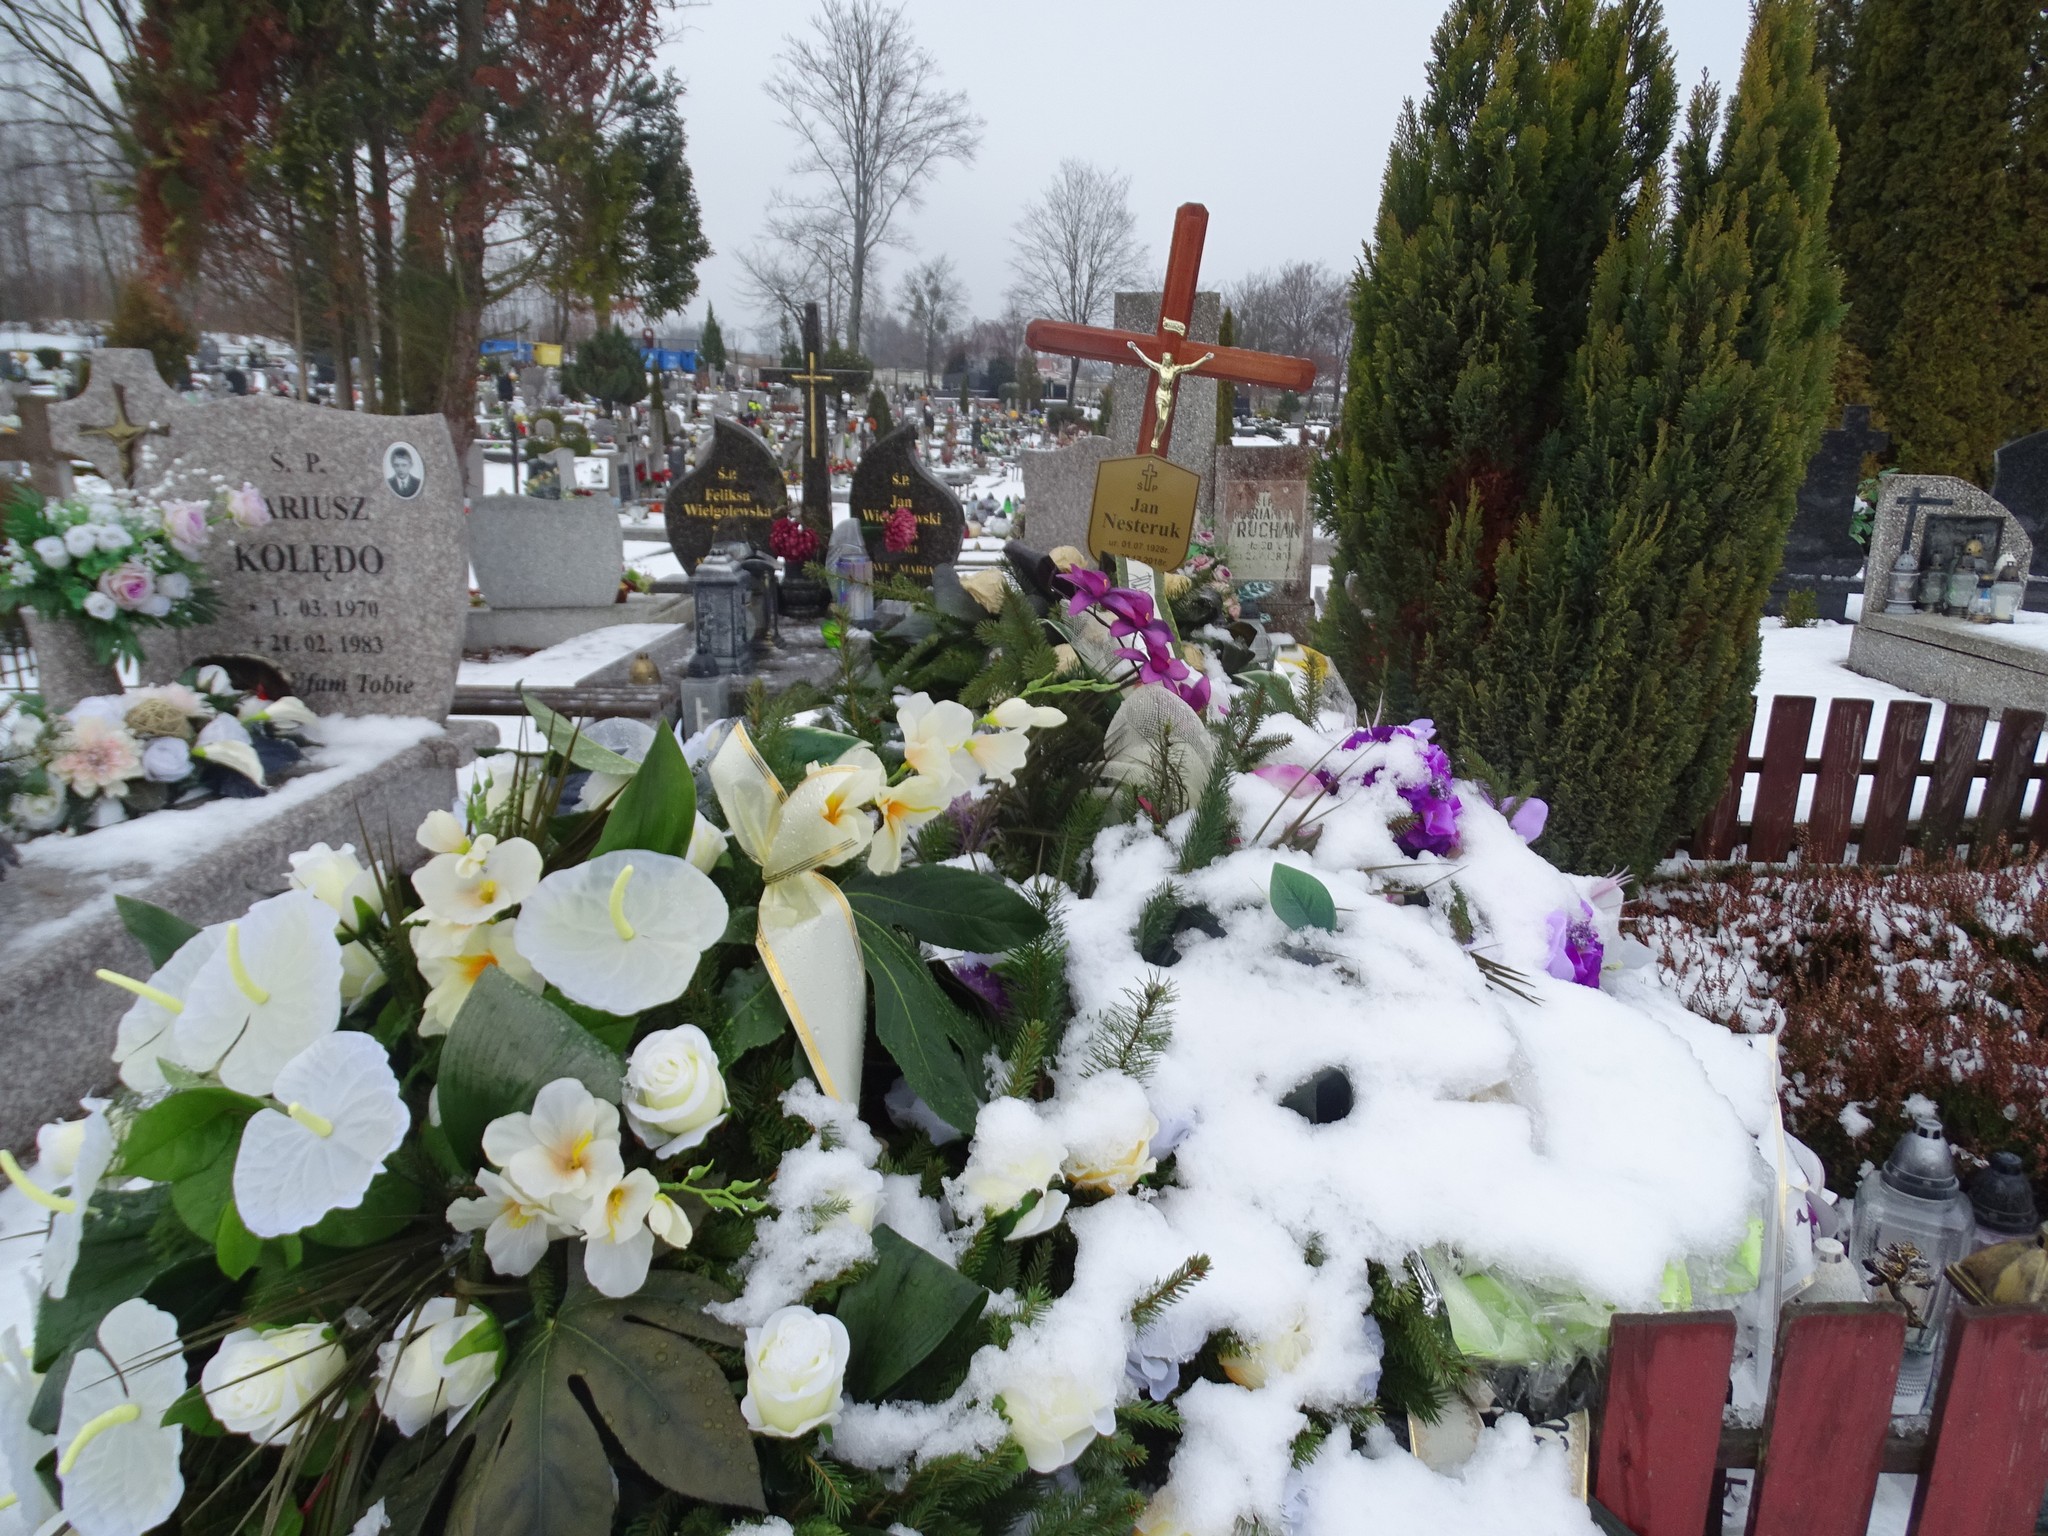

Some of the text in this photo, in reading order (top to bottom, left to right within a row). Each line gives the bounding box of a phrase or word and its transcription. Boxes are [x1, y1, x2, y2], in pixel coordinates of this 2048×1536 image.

[305, 452, 327, 474] P.
[705, 488, 751, 502] Feliksa
[890, 494, 913, 509] Jan
[263, 495, 369, 520] ARIUSZ
[1130, 498, 1159, 515] Jan
[1102, 512, 1181, 539] Nesteruk
[235, 544, 385, 581] KOLĘDO
[899, 564, 935, 575] MARIA
[299, 599, 328, 617] 03.
[335, 600, 379, 619] 1970
[340, 635, 384, 654] 1983
[357, 674, 414, 694] Tobie
